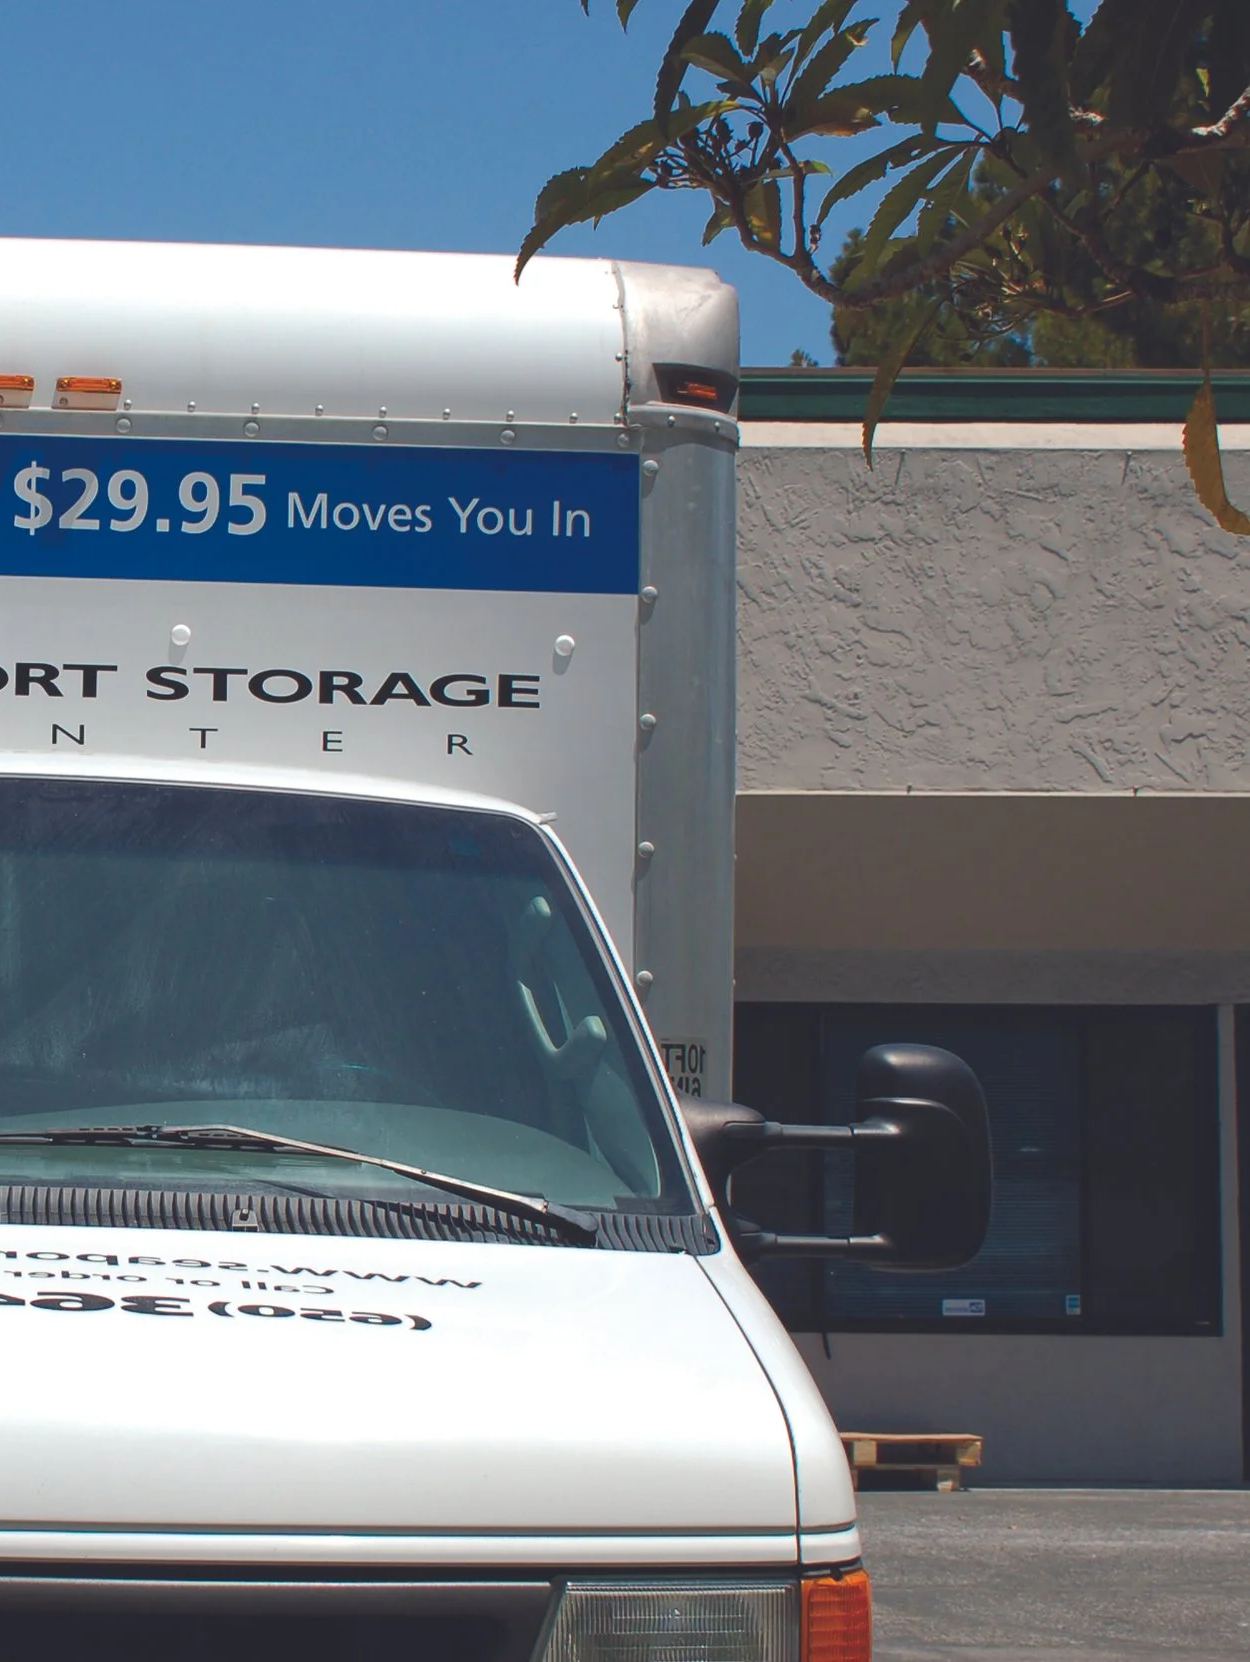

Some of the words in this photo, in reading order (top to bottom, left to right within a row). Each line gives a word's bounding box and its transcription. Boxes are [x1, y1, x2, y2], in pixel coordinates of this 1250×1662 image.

[13, 460, 267, 536] $29.95
[288, 491, 432, 533] Moves
[448, 497, 533, 536] You
[552, 500, 590, 537] In
[145, 666, 541, 709] STORAGE
